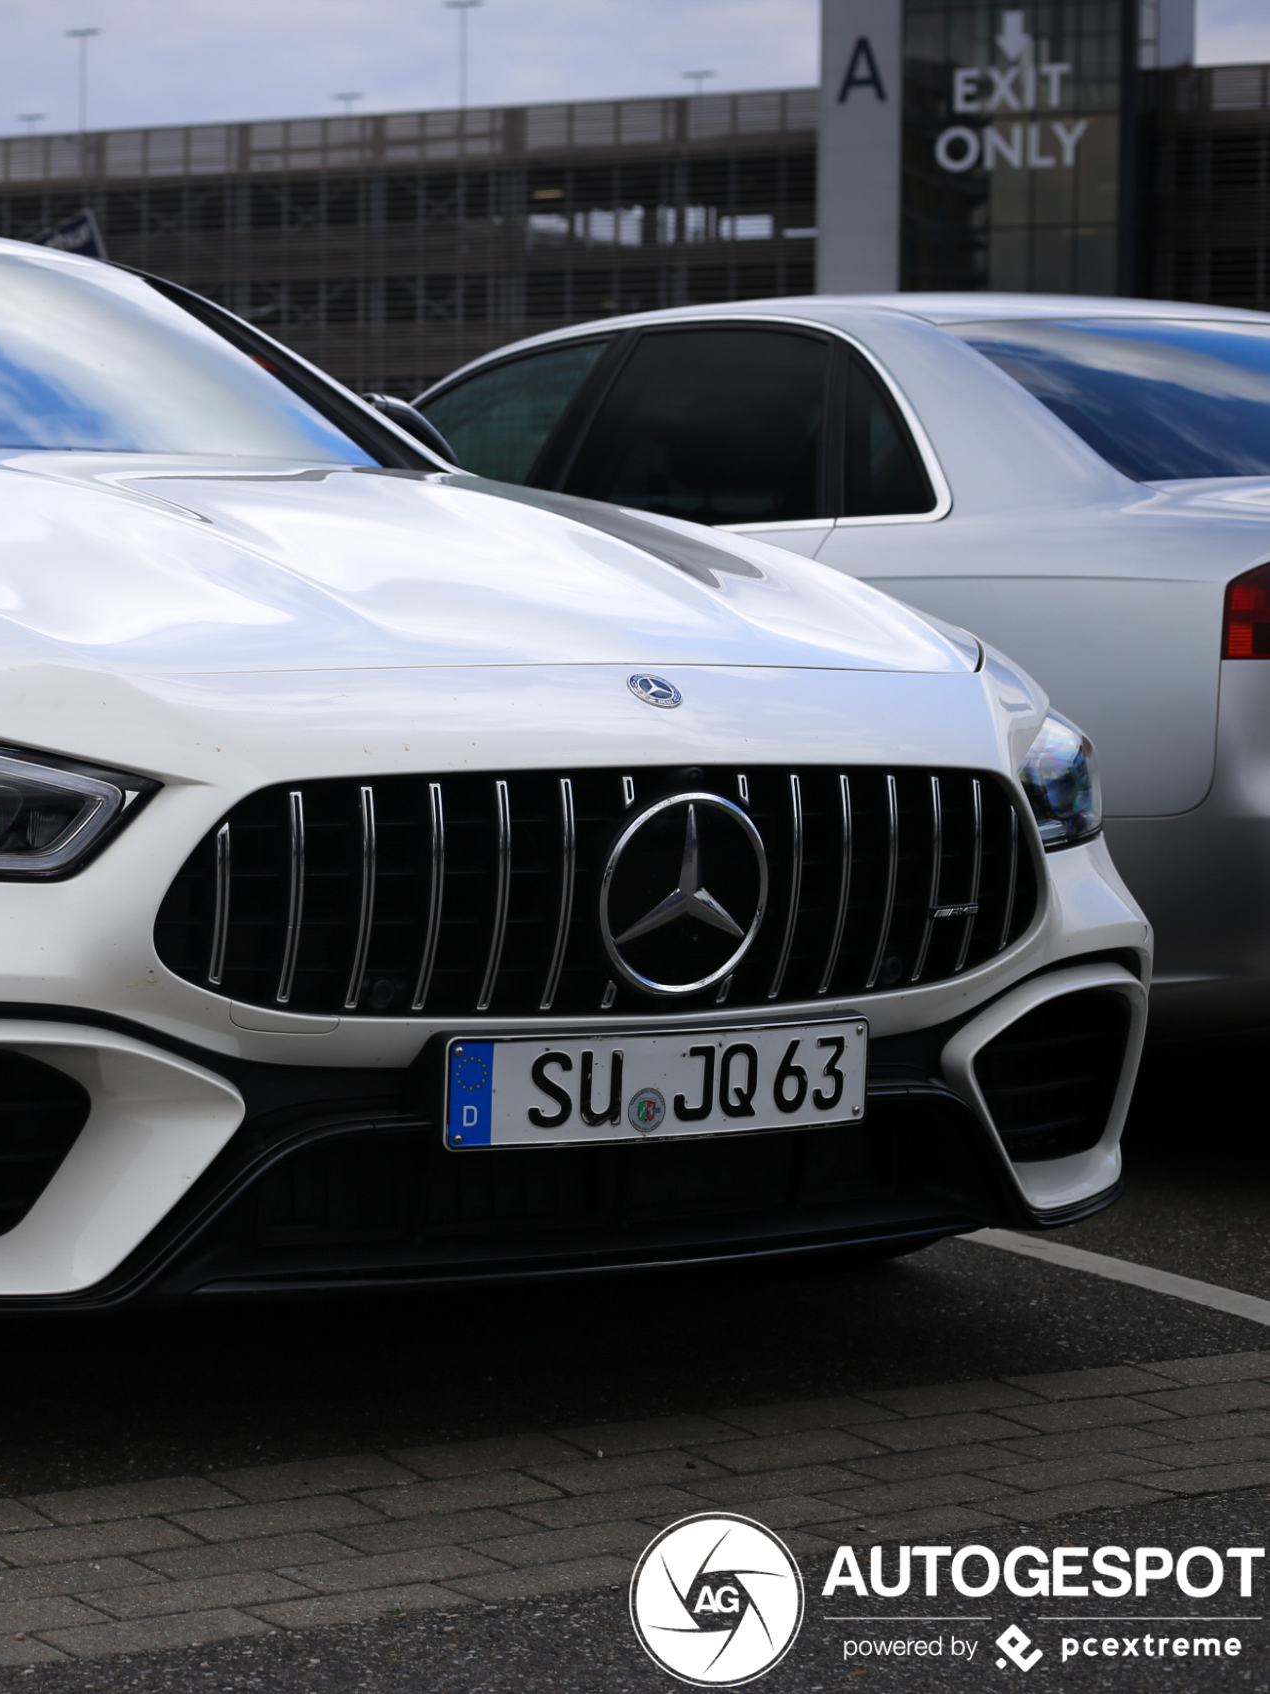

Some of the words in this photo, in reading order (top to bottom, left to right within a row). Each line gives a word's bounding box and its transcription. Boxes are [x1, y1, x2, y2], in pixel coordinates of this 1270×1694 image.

[837, 36, 887, 104] A
[952, 62, 1071, 113] EXIT
[934, 120, 1088, 172] ONLY
[526, 1048, 625, 1129] SU
[672, 1041, 759, 1123] JQ
[772, 1034, 846, 1114] 63
[462, 1104, 479, 1128] D
